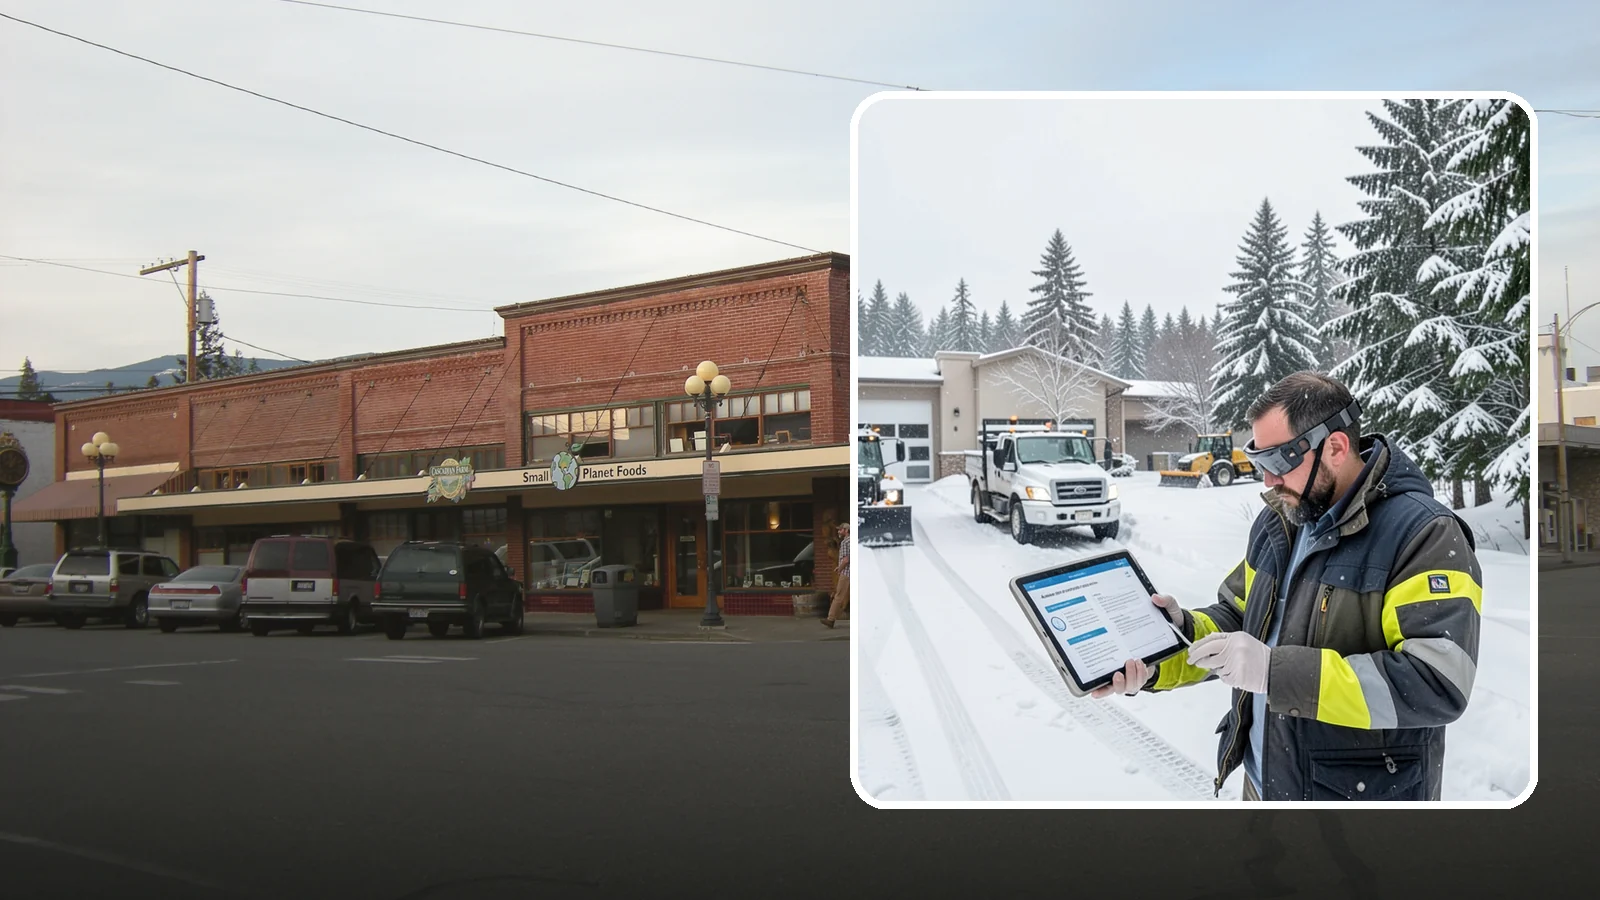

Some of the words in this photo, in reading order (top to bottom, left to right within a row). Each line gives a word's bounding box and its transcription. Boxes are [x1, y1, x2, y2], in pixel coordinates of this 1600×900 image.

[523, 471, 549, 483] Small
[583, 467, 614, 479] Planet
[616, 464, 647, 477] Foods
